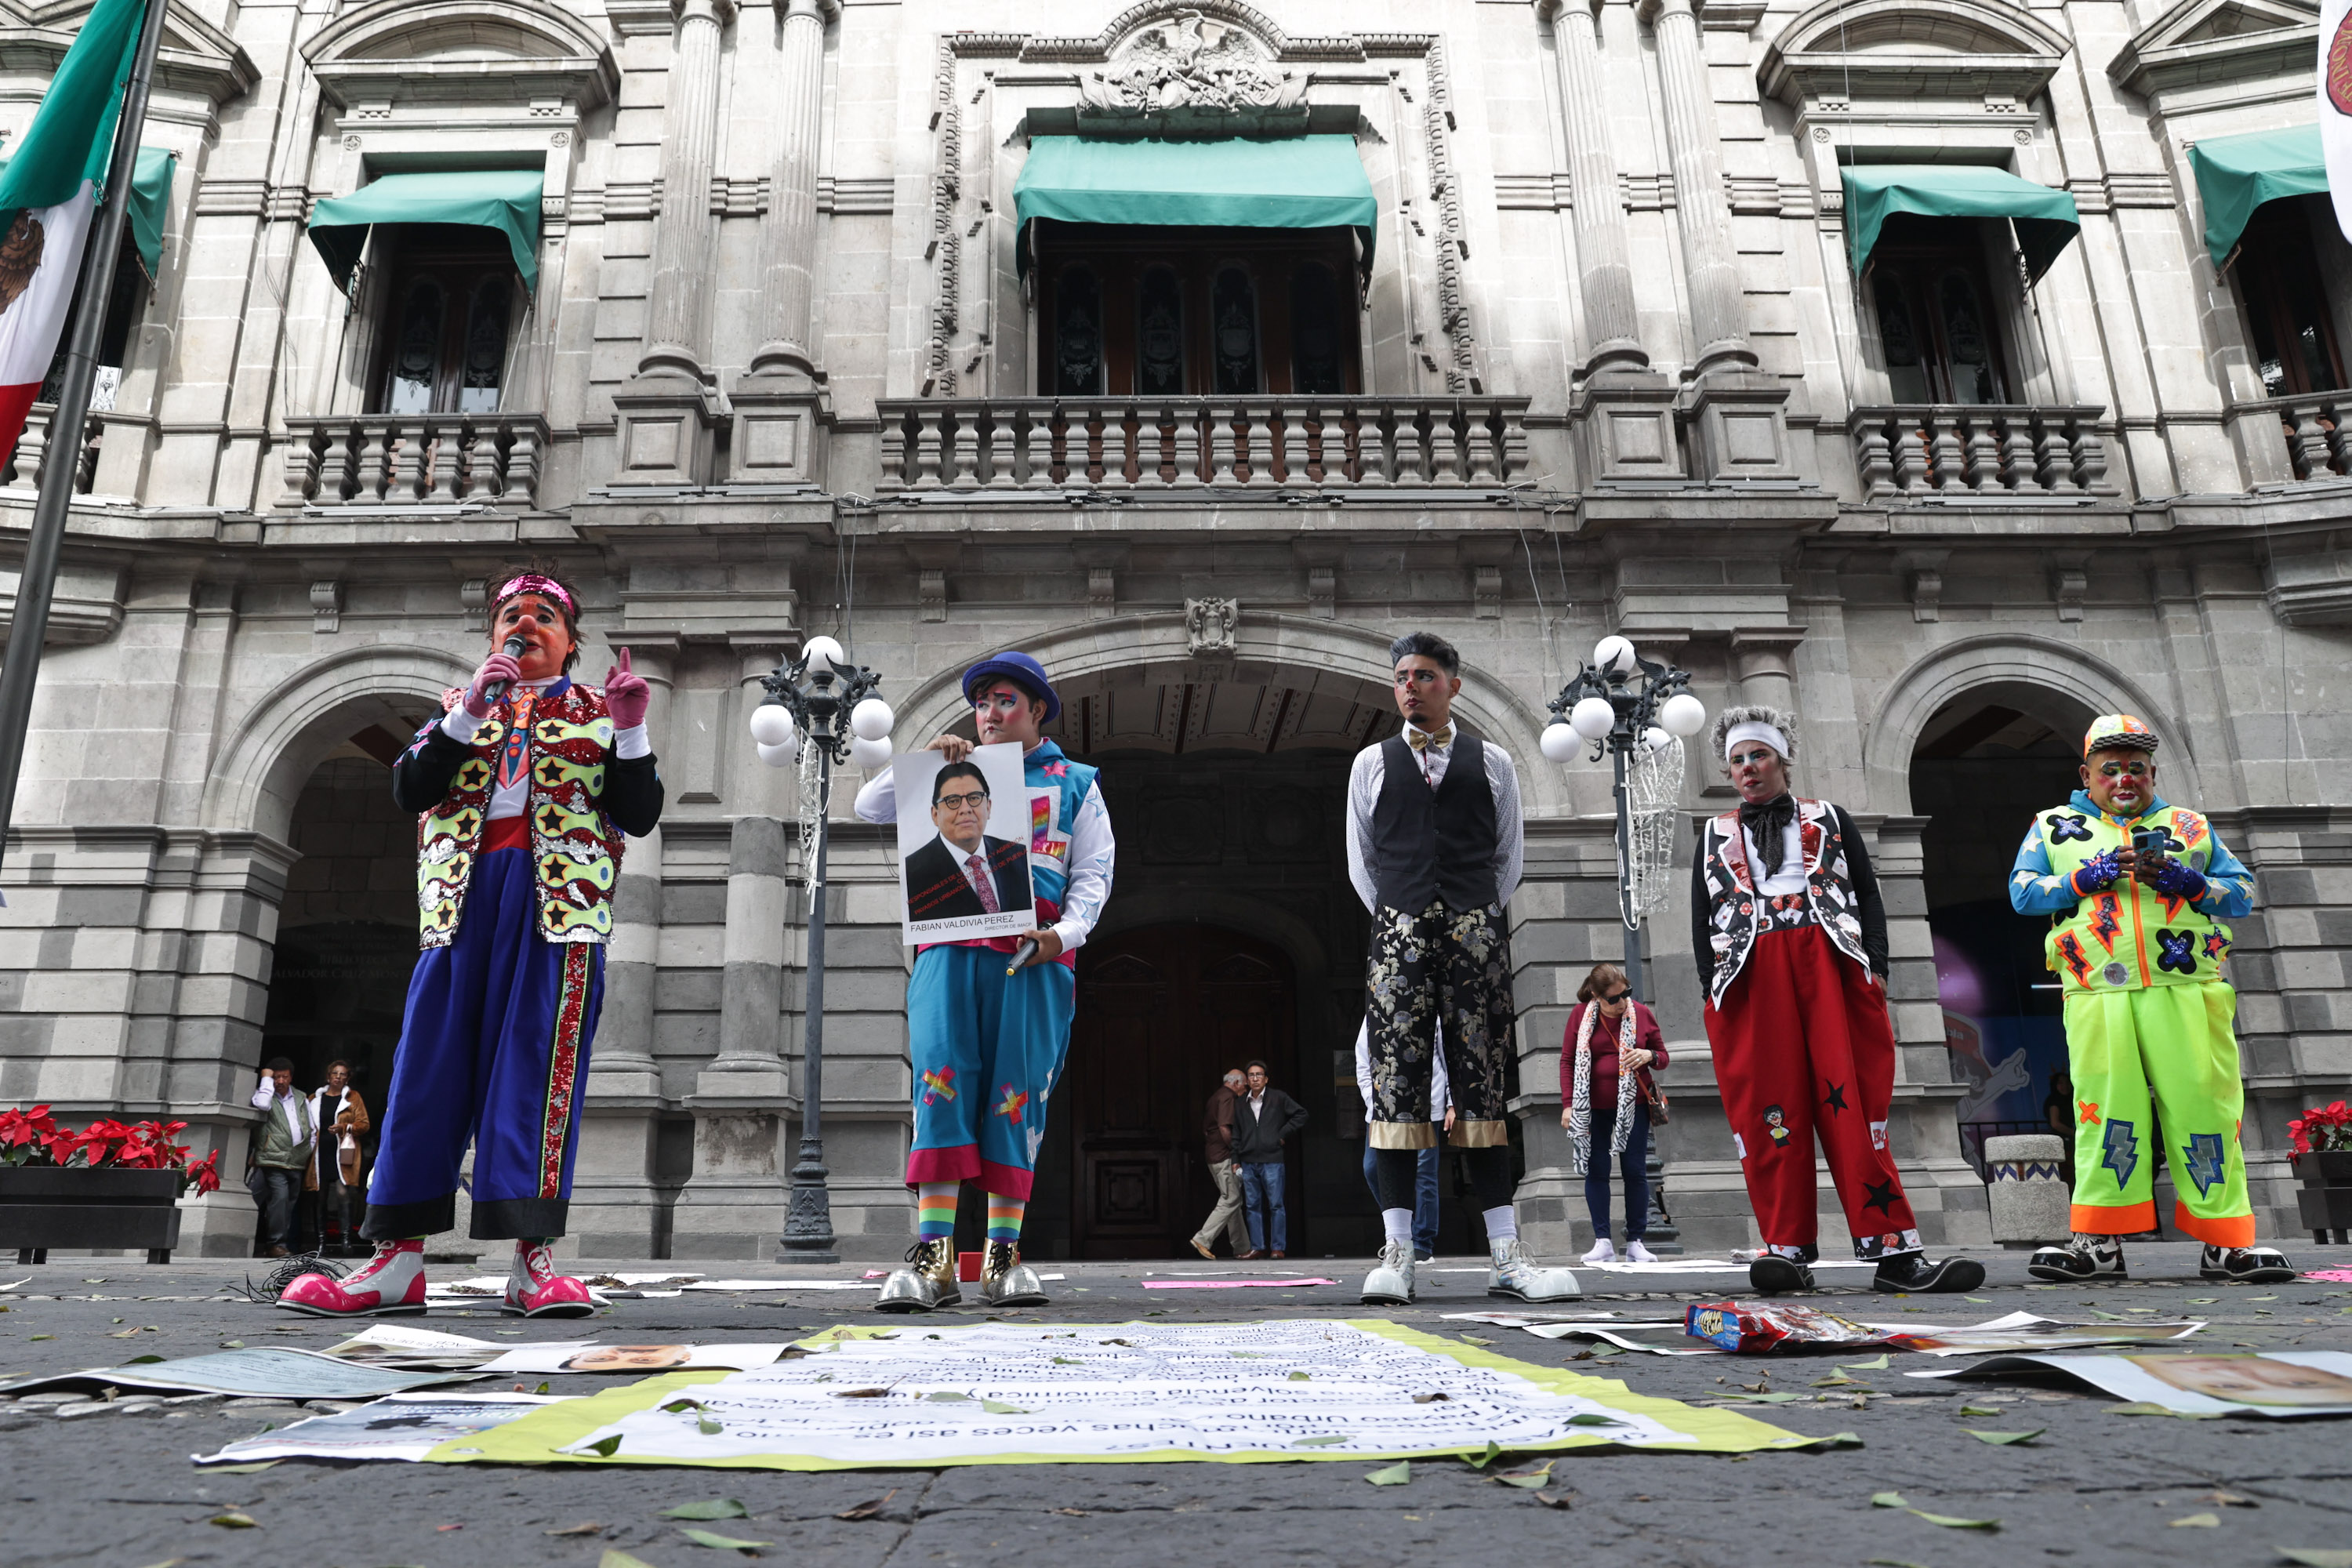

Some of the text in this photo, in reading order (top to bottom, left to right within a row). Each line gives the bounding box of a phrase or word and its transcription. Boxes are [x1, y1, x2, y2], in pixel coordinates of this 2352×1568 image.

[1030, 795, 1067, 864] L
[947, 873, 957, 882] DE
[914, 898, 940, 915] PAYASOS
[938, 883, 966, 902] URBANOS
[910, 915, 1014, 932] FABIAN VALDIVIA PEREZ
[1226, 1414, 1348, 1423] Urbano
[906, 1429, 959, 1440] así
[971, 1425, 1078, 1437] veces
